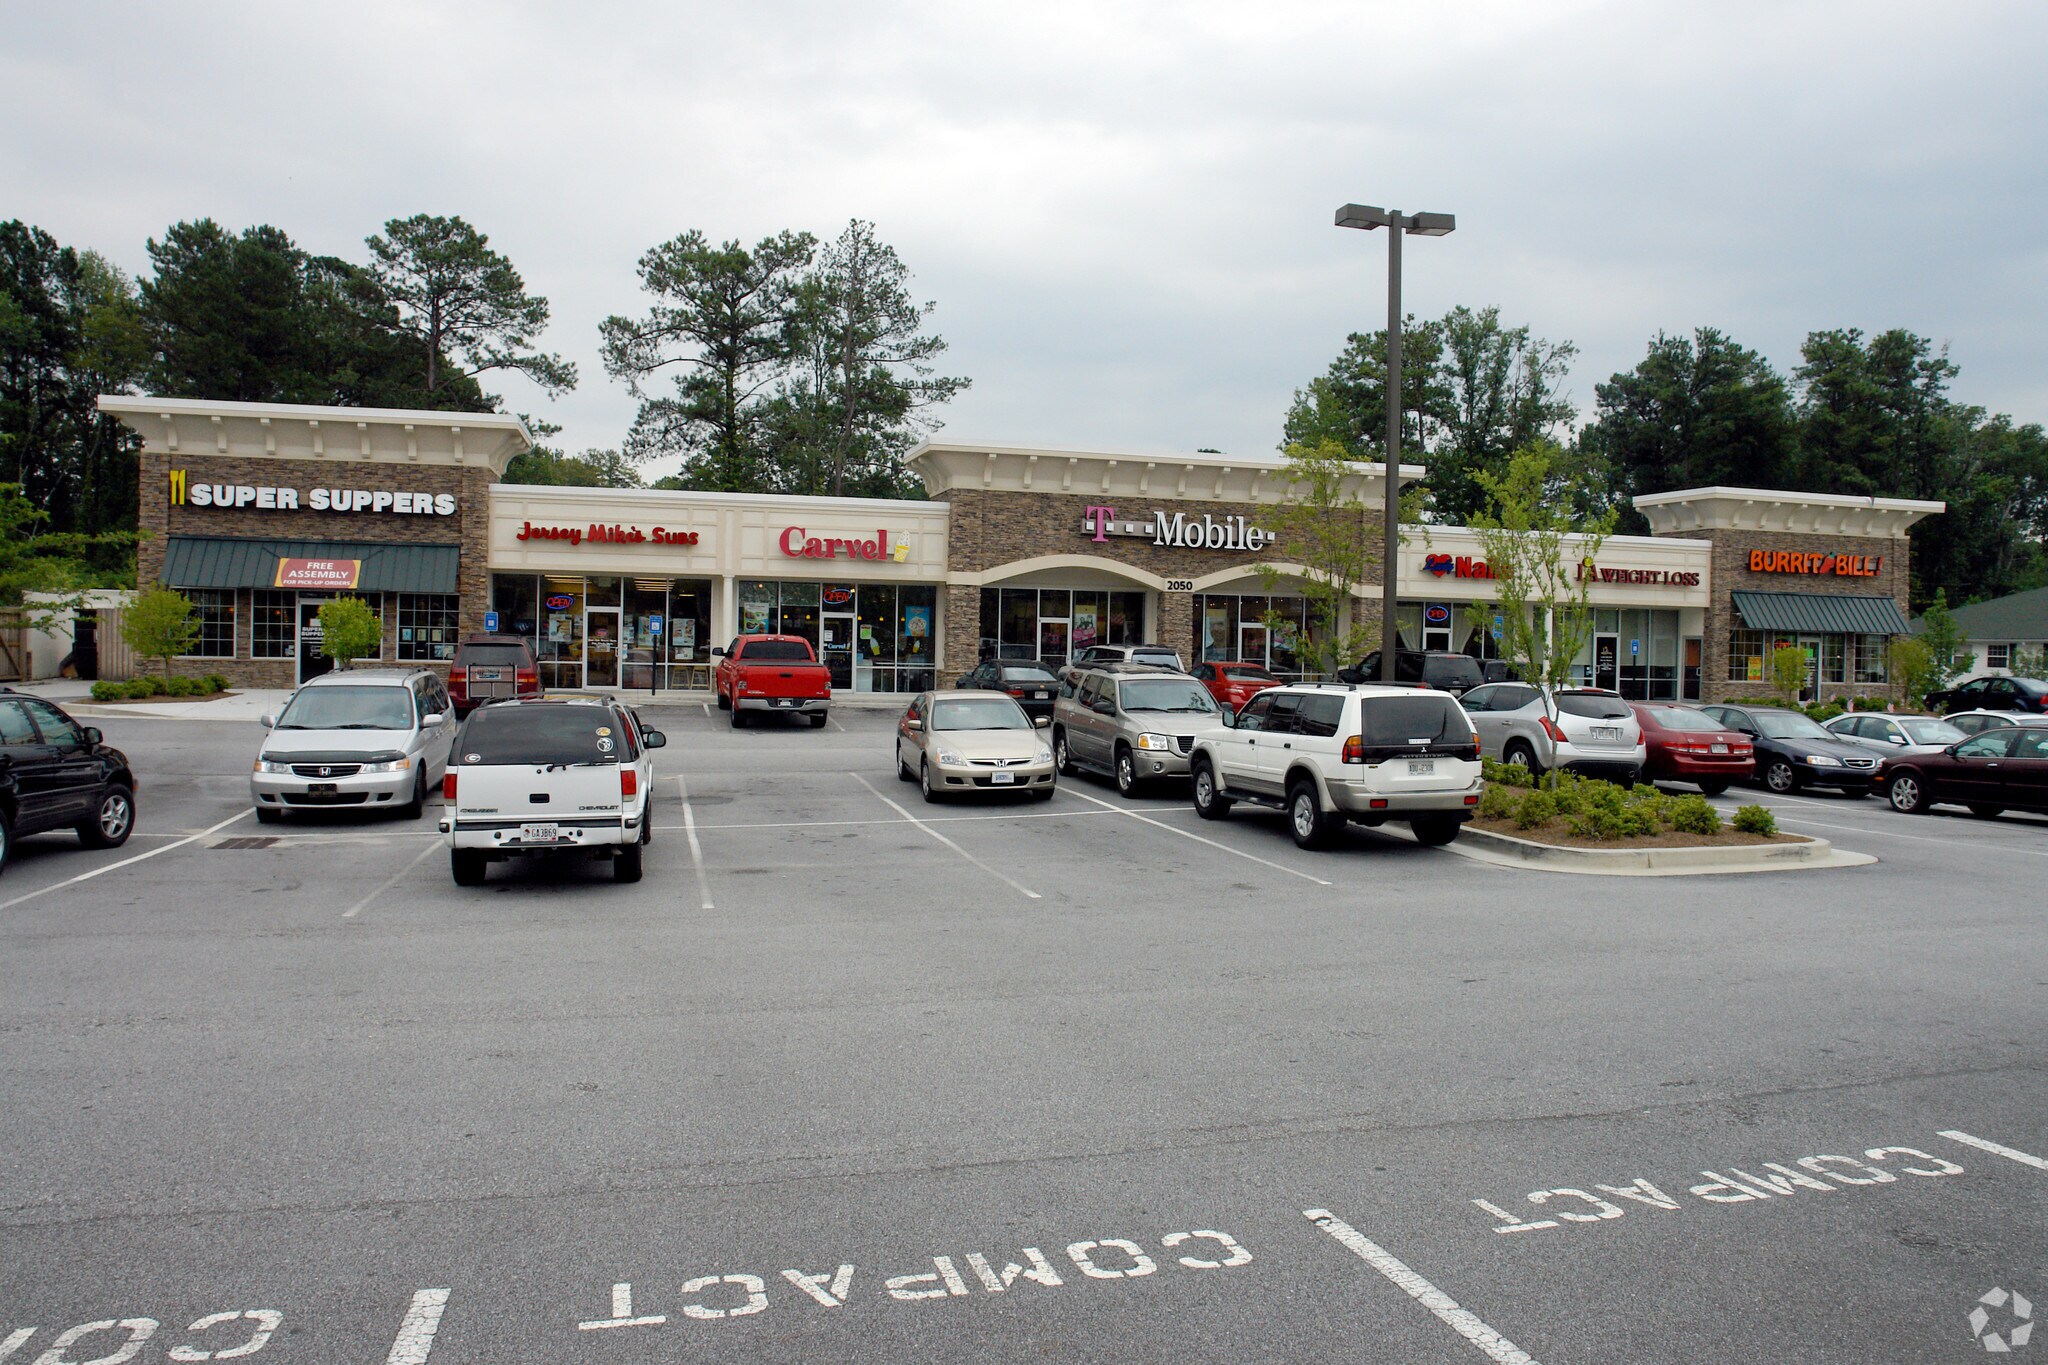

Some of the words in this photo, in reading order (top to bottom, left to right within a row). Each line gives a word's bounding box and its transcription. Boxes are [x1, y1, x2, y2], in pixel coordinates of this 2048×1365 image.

[190, 483, 299, 510] SUPER
[308, 488, 456, 516] SUPPERS
[516, 521, 581, 546] Jersey
[587, 524, 647, 544] Mike's
[1152, 511, 1264, 551] Mobile
[779, 526, 888, 560] Carvel
[288, 570, 349, 579] ASSEMBLY
[306, 561, 334, 570] FREE
[1836, 554, 1884, 576] BILL!
[1167, 581, 1193, 591] 2050
[1600, 568, 1661, 585] WEIGHT
[1663, 571, 1700, 587] LOSS
[548, 597, 571, 607] OPEN
[824, 591, 850, 602] OPEN
[1429, 609, 1446, 618] OPEN
[1470, 1146, 1965, 1234] COMPACT
[578, 1229, 1253, 1330] COMPACT
